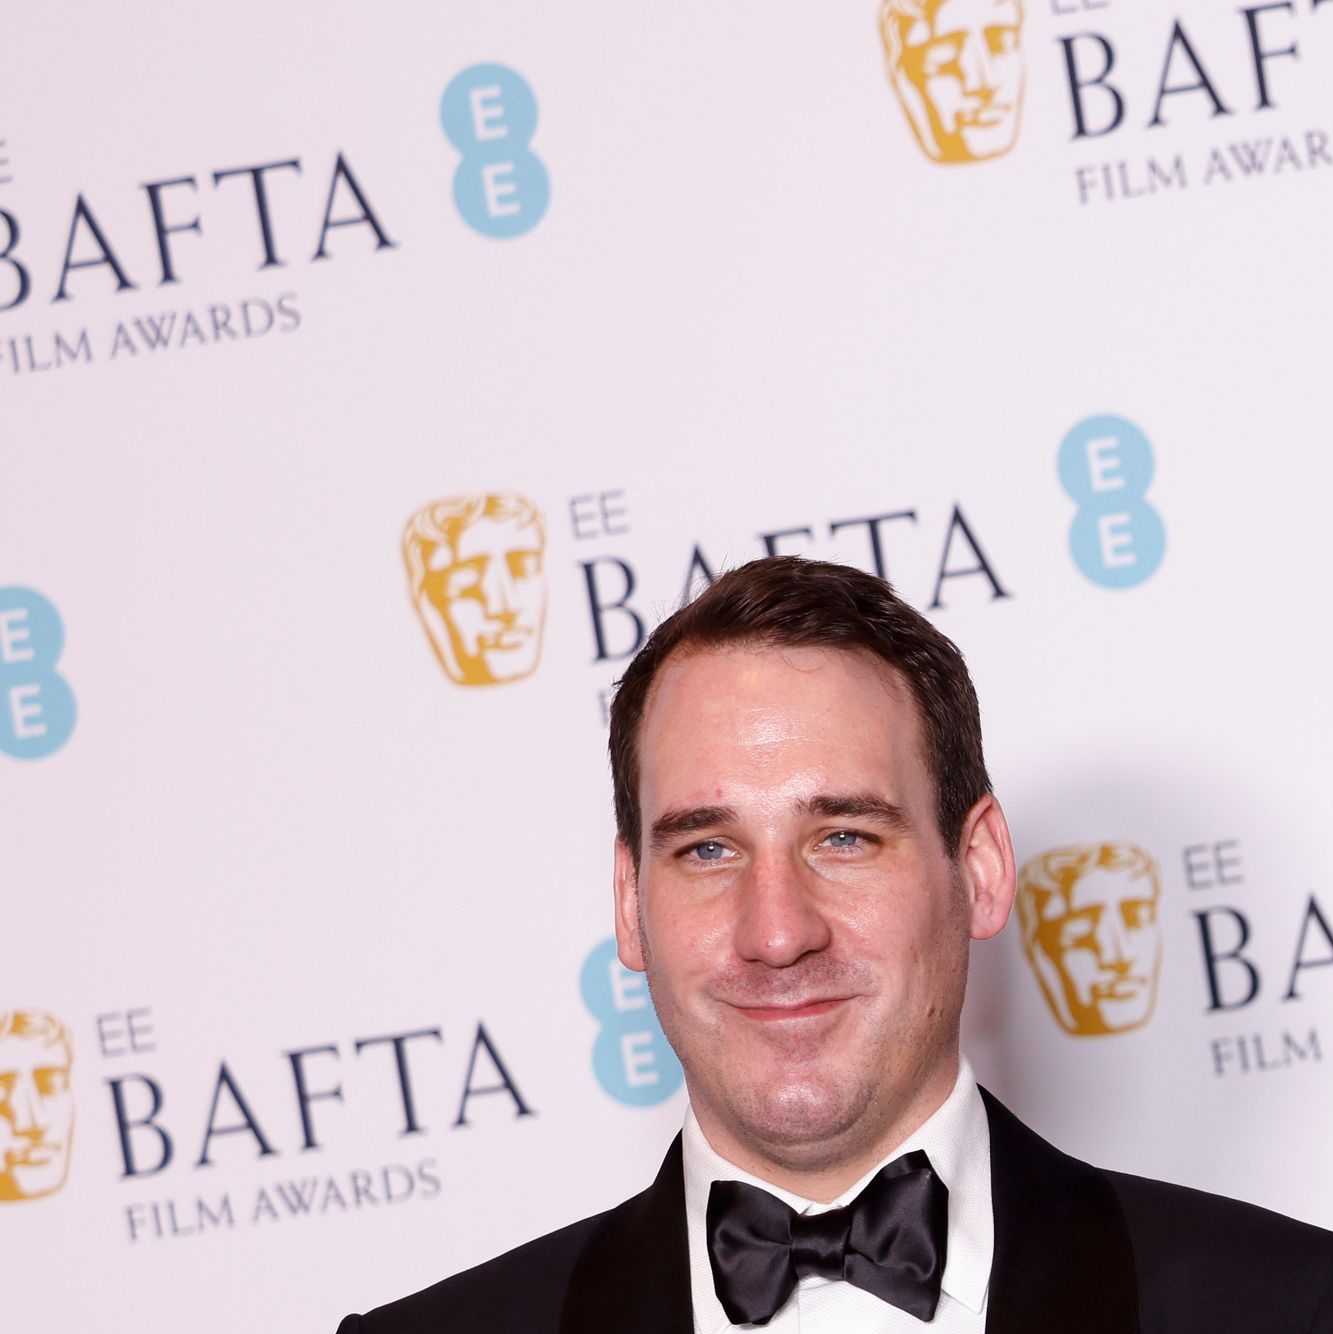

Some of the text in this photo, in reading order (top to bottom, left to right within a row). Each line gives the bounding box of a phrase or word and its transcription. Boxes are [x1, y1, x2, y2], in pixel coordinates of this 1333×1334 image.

[1074, 154, 1188, 204] FILM
[109, 292, 303, 359] AWARDS
[569, 490, 630, 541] EE
[1182, 838, 1244, 891] EE
[97, 1007, 157, 1059] EE
[1211, 1027, 1323, 1078] FILM
[104, 1019, 539, 1181] BAFTA
[124, 1157, 443, 1245] FILM AWARDS
